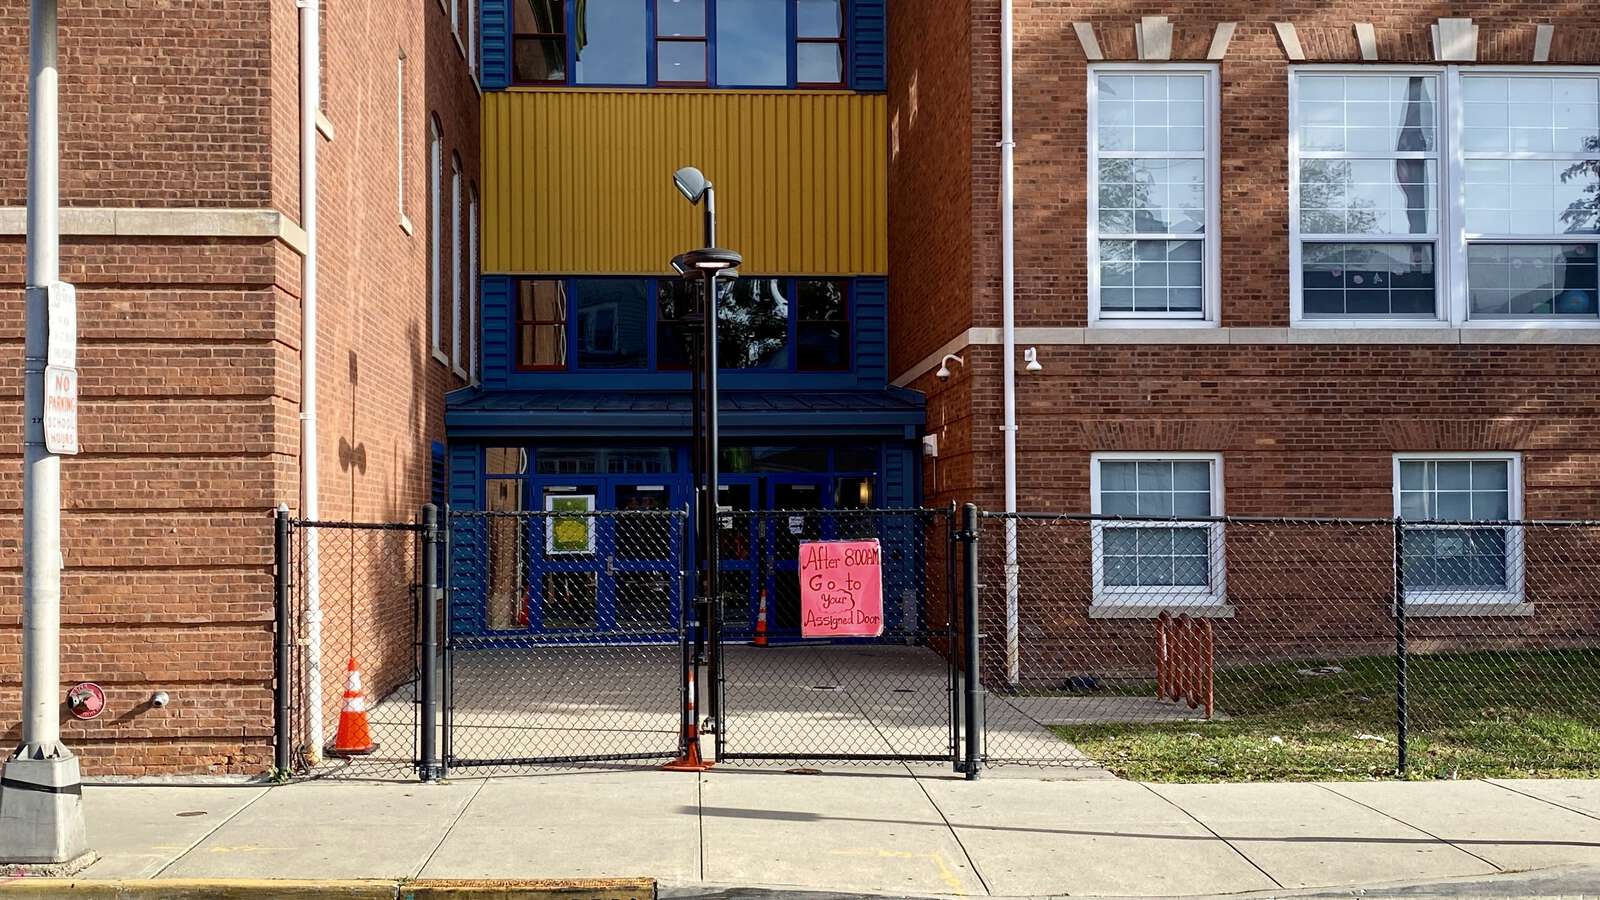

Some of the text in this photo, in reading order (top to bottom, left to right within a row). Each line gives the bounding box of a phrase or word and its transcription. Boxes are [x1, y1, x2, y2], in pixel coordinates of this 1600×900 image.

[55, 375, 70, 392] NO
[49, 395, 75, 413] PARKING
[802, 546, 840, 570] After
[808, 572, 862, 592] Go to
[821, 593, 847, 609] Your
[803, 609, 854, 630] Assigned
